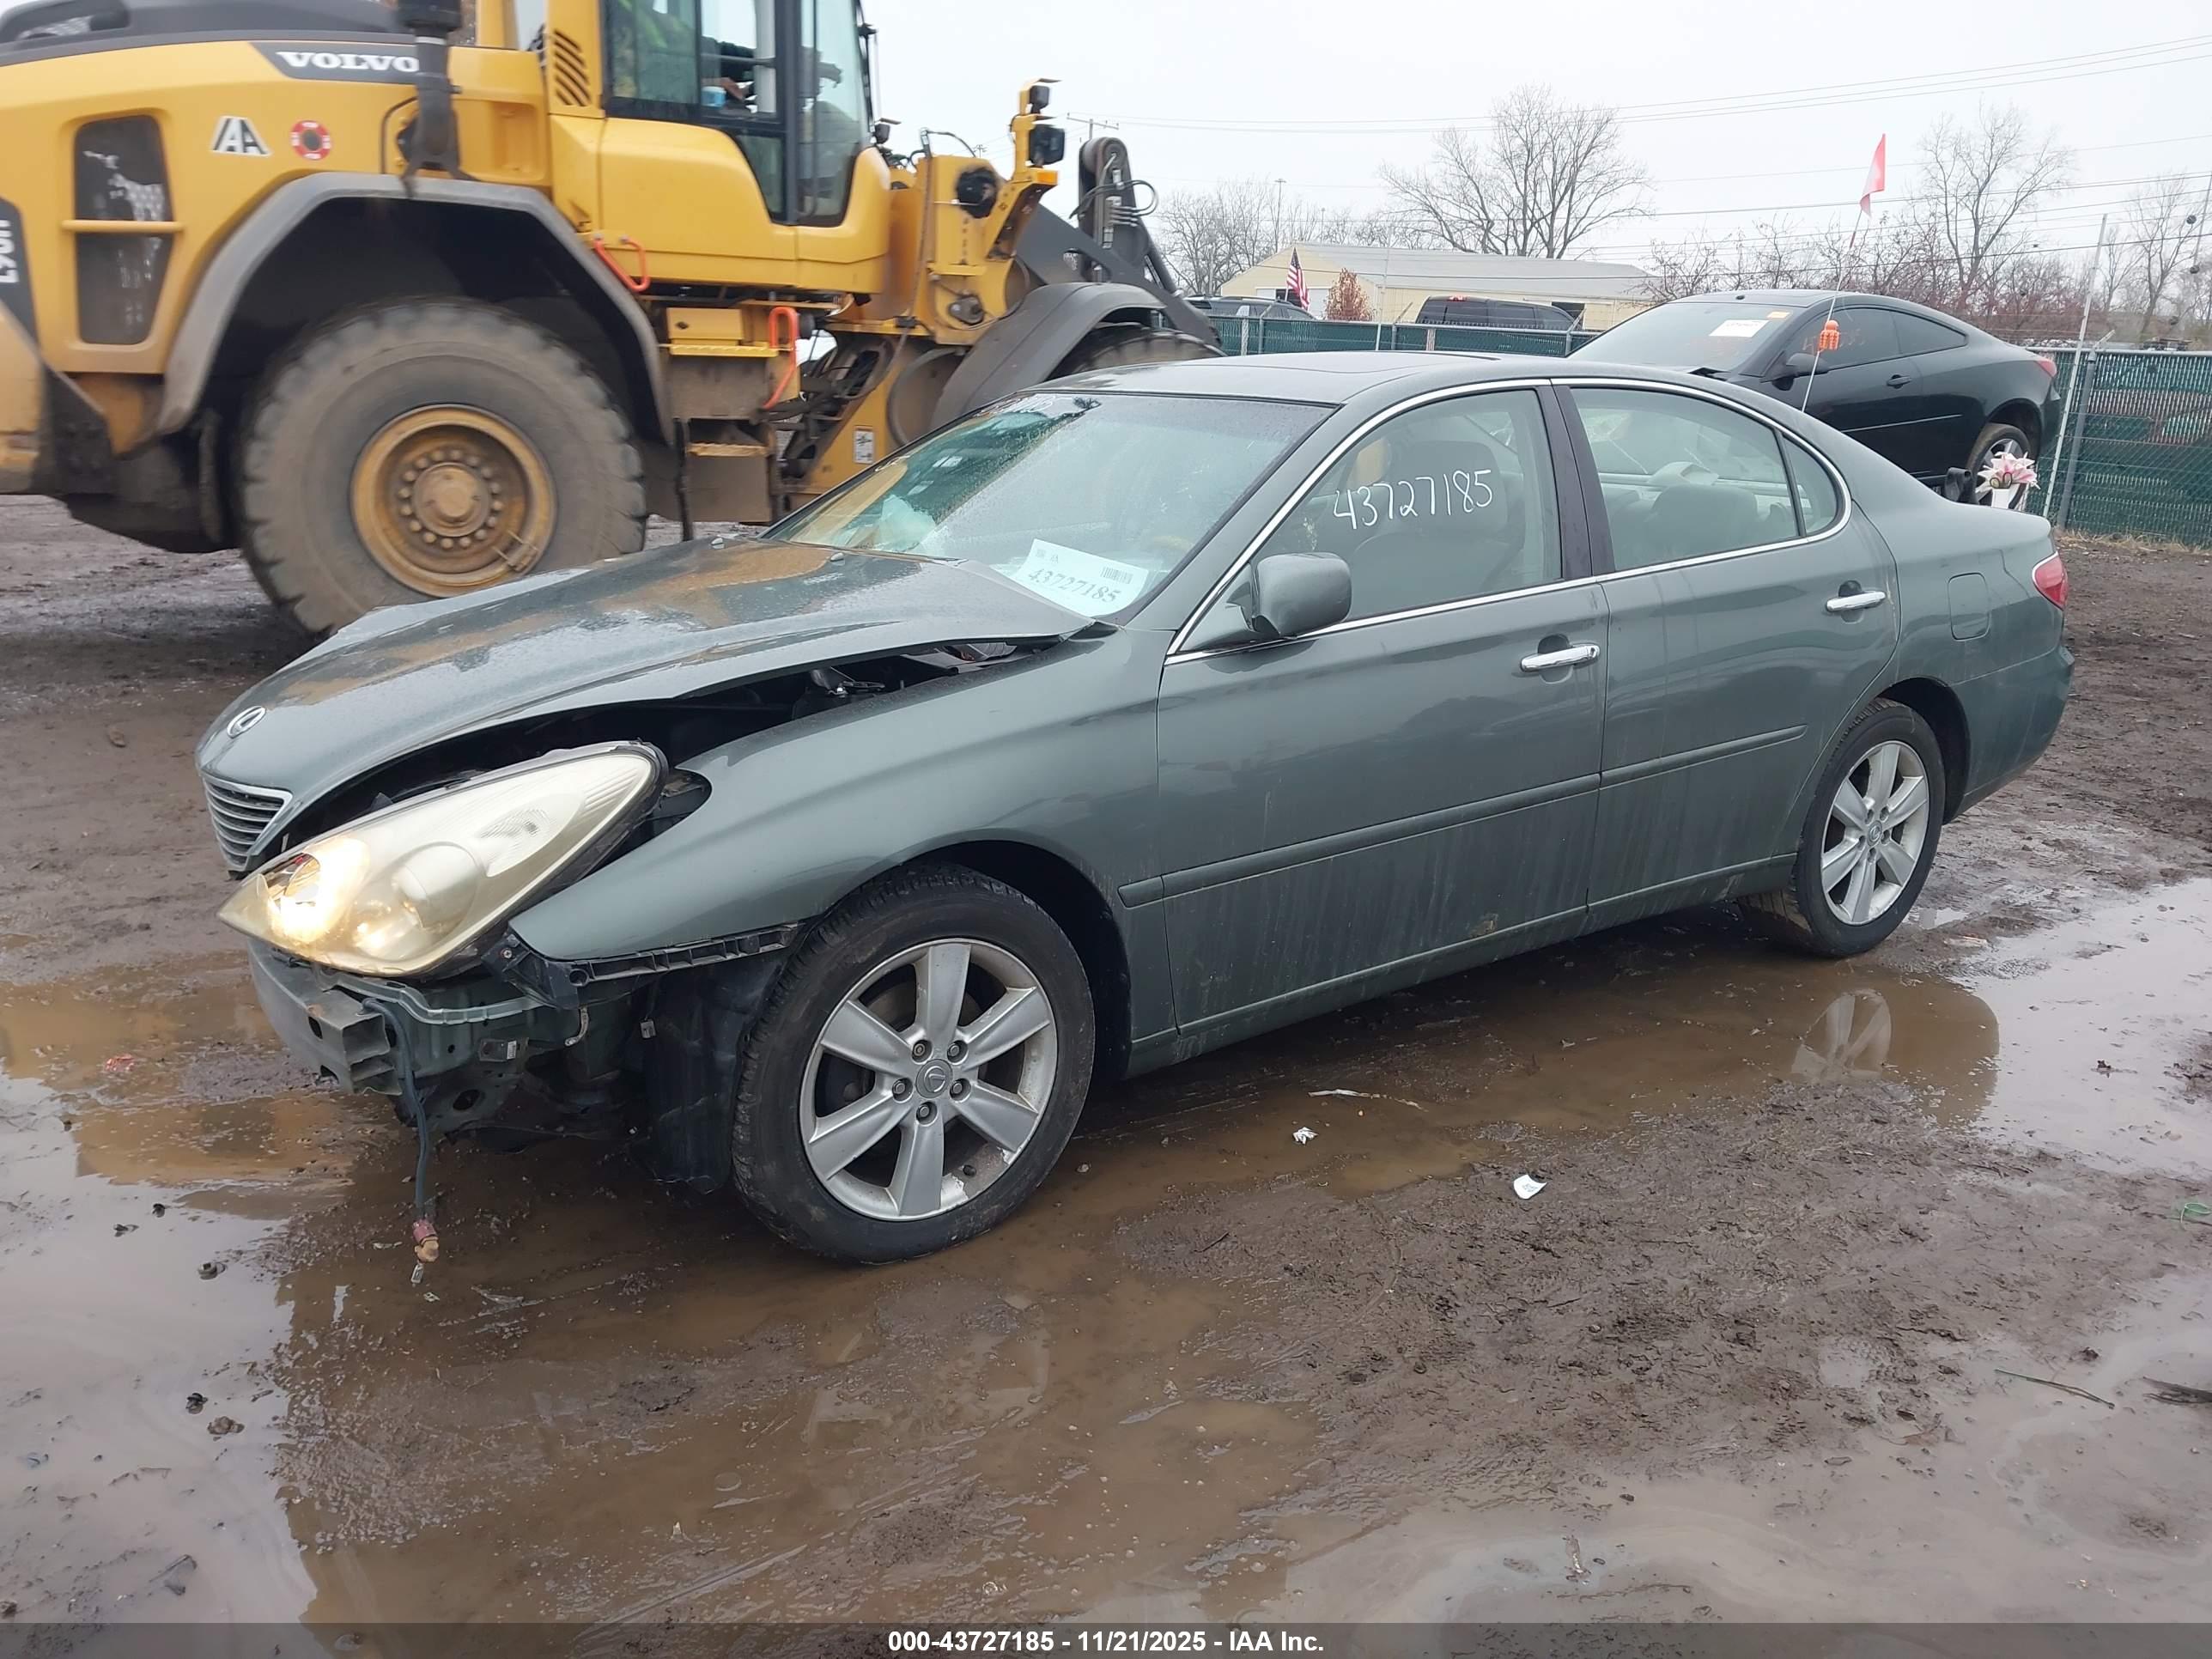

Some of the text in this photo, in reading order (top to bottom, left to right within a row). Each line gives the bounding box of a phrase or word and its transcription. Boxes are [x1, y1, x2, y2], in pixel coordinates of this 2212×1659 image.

[276, 52, 419, 72] VOLVO
[1333, 470, 1493, 530] 43727185
[1028, 568, 1121, 603] 43727185
